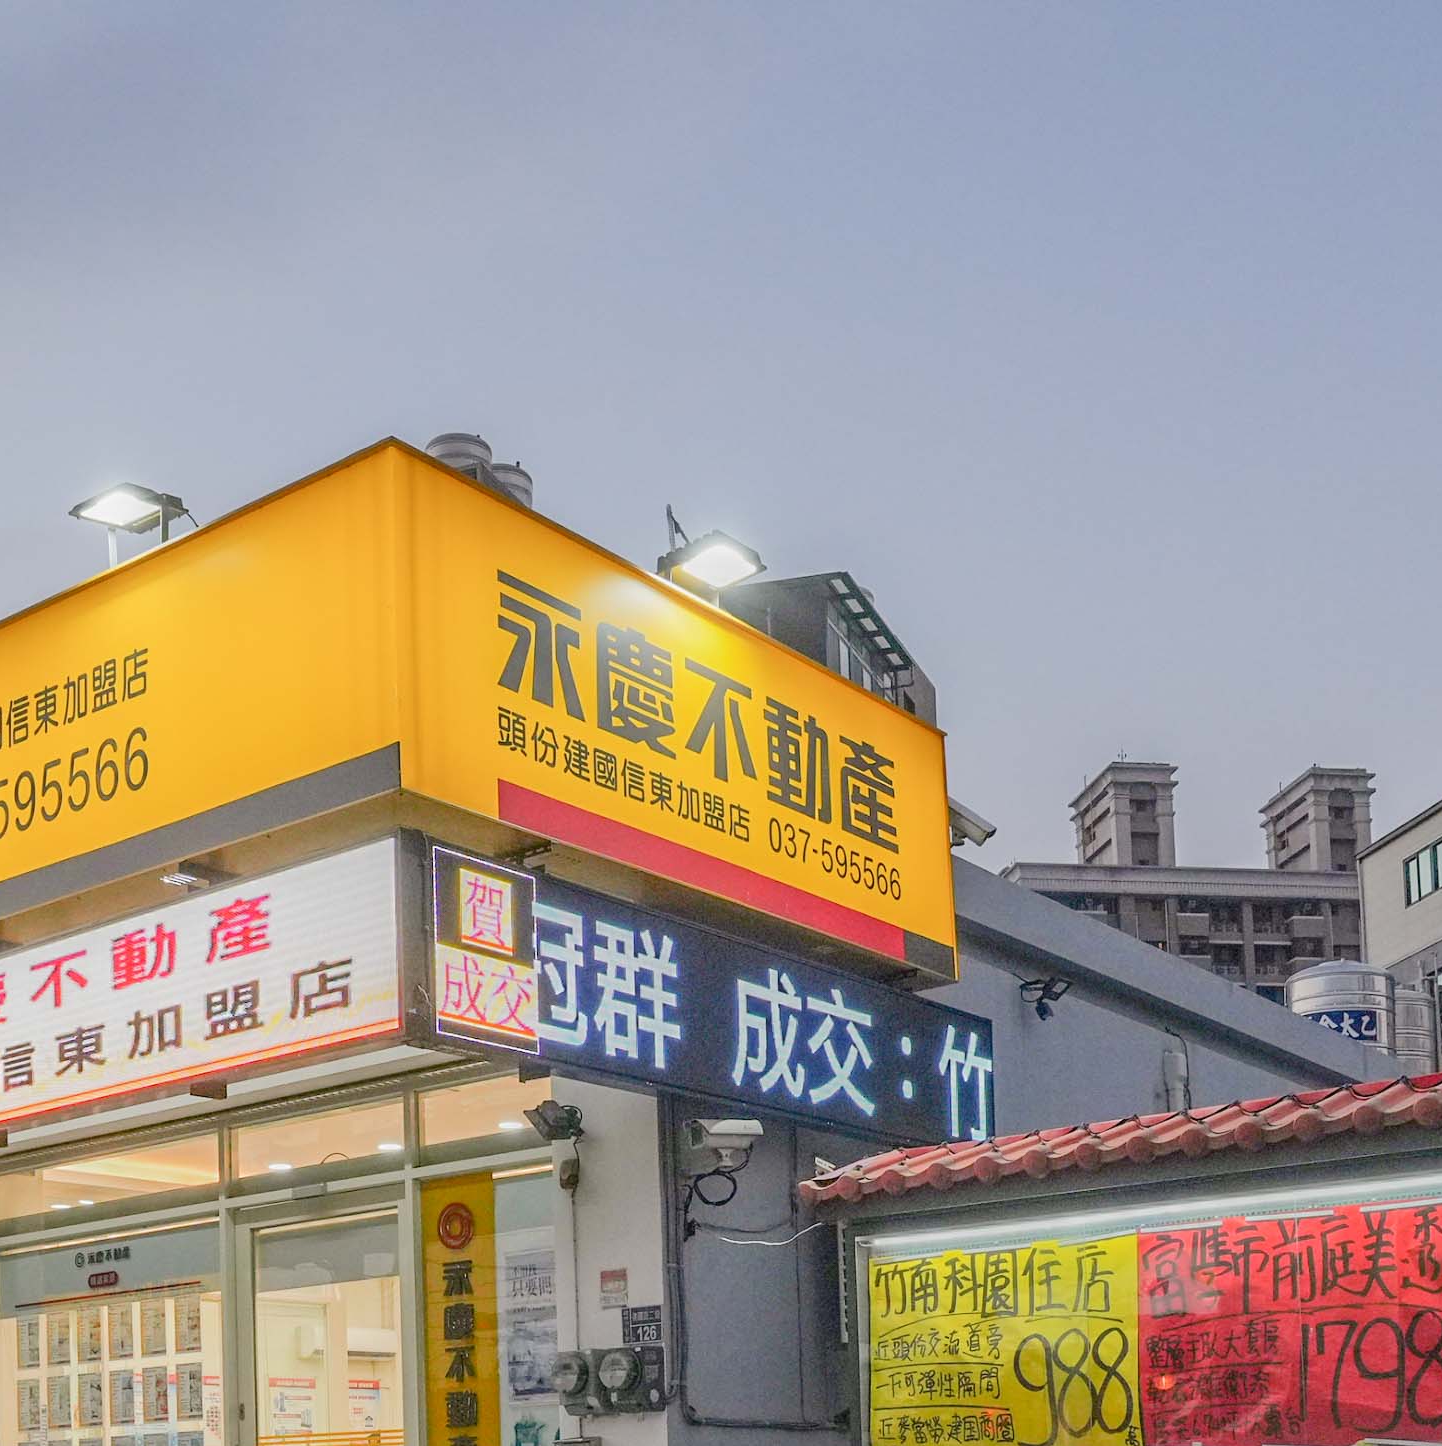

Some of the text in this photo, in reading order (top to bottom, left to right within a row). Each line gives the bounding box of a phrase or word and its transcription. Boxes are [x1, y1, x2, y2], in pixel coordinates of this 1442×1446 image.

[497, 569, 898, 854] 永慶不動產
[498, 707, 901, 900] 頭份建國信東加盟店 037-595566
[466, 876, 507, 945] 賀
[444, 956, 534, 1032] 成交
[637, 1326, 657, 1341] 126
